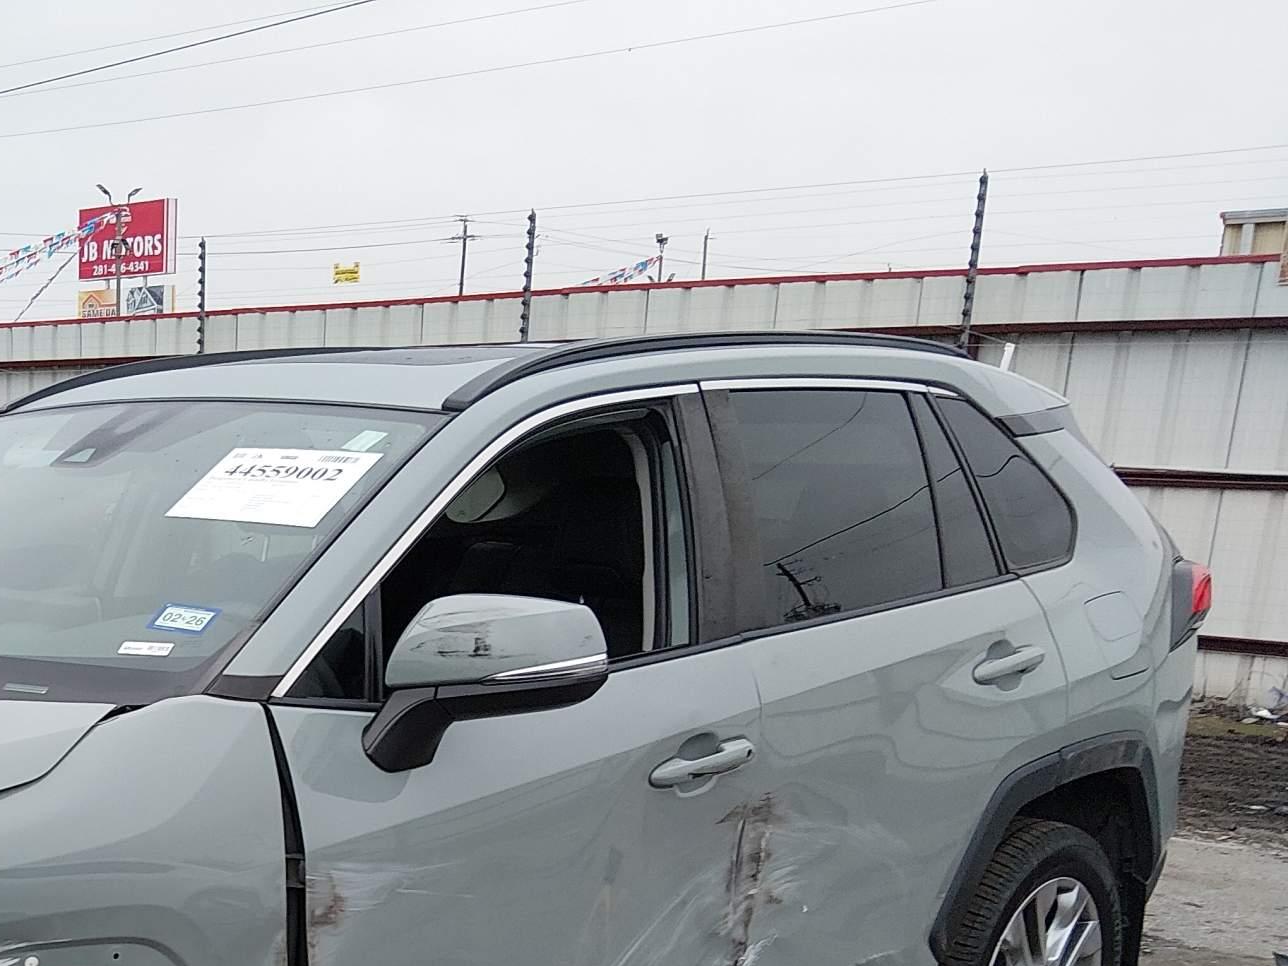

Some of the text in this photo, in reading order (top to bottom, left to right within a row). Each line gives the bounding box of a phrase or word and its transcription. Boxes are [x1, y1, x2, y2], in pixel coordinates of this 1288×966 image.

[81, 241, 98, 262] JB
[93, 261, 149, 276] 281-46-4341
[224, 464, 344, 482] 44559002
